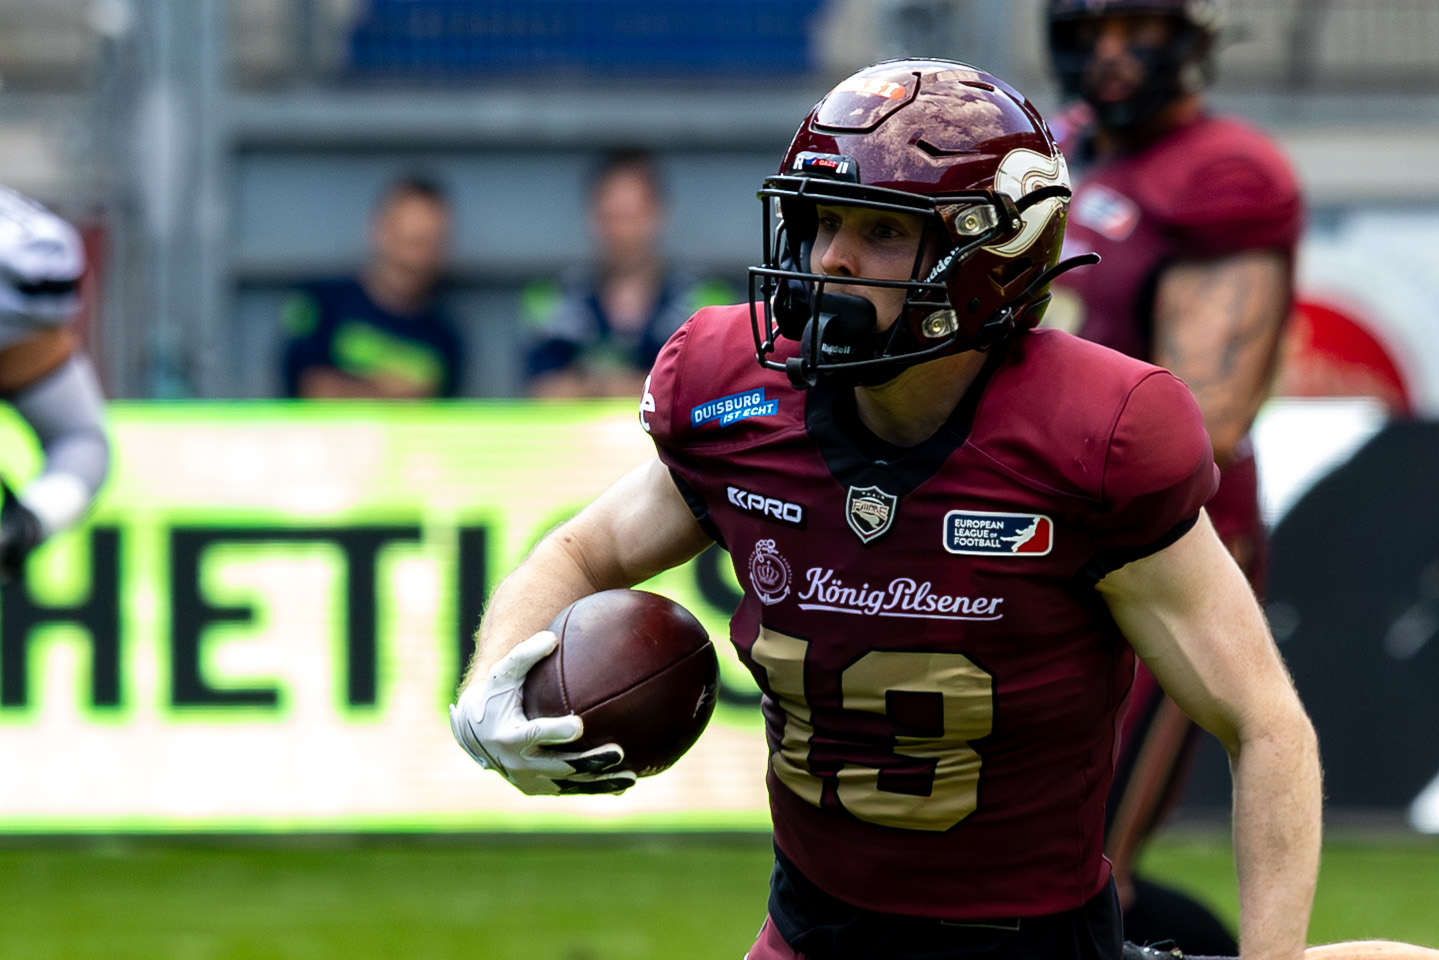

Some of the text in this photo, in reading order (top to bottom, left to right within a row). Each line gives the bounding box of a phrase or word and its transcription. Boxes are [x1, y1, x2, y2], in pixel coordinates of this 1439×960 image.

[694, 393, 761, 423] DUISBURG
[723, 403, 774, 424] IST ECHT
[954, 518, 1004, 529] EUROPEAN
[954, 528, 989, 538] LEAGUE
[953, 537, 1001, 548] FOOTBALL
[751, 624, 993, 832] 13
